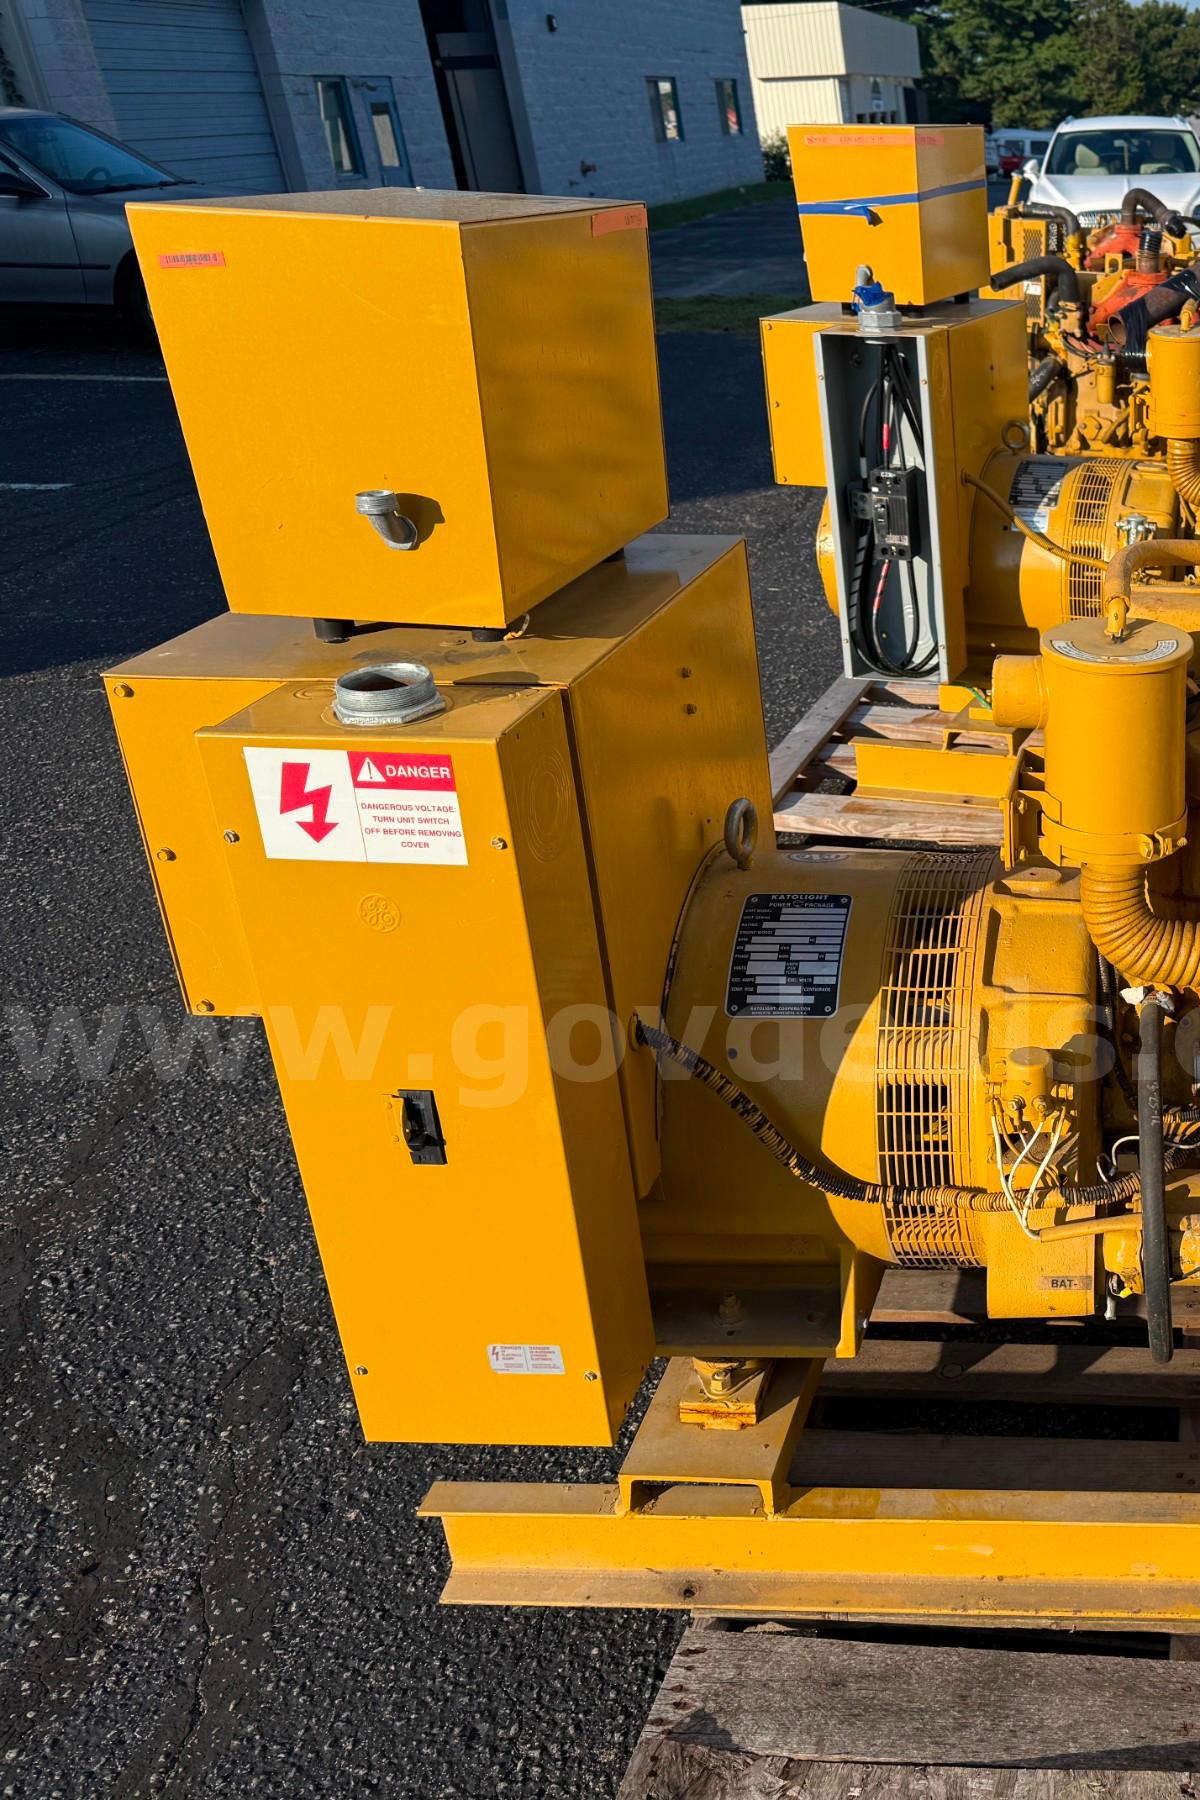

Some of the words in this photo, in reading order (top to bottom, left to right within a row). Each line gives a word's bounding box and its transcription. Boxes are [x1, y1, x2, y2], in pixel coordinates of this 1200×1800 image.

[385, 764, 451, 779] DANGER
[361, 802, 413, 812] DANGEROUS
[372, 815, 395, 824] TURN
[397, 816, 416, 824] UNIT
[417, 816, 450, 825] SWITCH
[383, 828, 416, 836] BEFORE
[418, 829, 462, 838] REMOVING
[401, 841, 430, 849] COVER
[1051, 1279, 1078, 1288] BAT-
